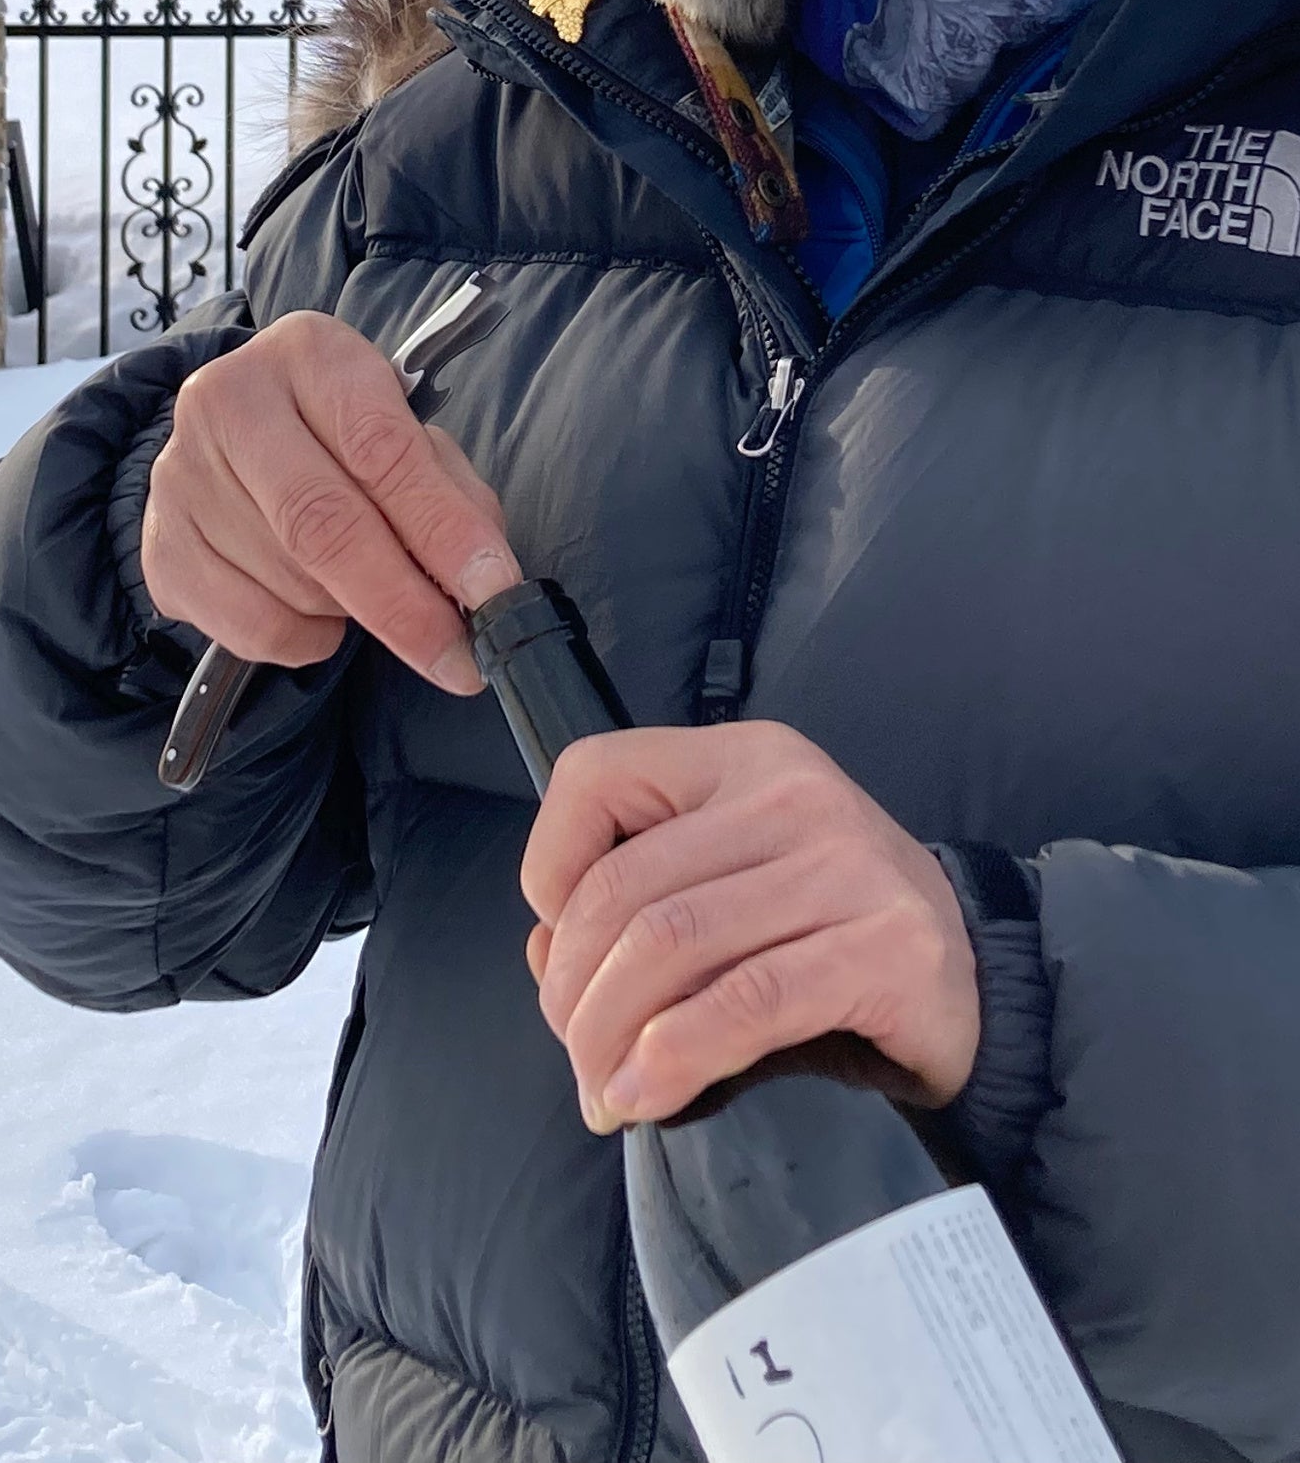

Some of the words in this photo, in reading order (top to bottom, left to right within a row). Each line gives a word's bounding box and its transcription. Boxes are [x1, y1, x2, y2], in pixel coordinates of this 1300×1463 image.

[1183, 123, 1272, 165] THE
[1095, 149, 1265, 206] NORTH
[1139, 195, 1252, 245] FACE
